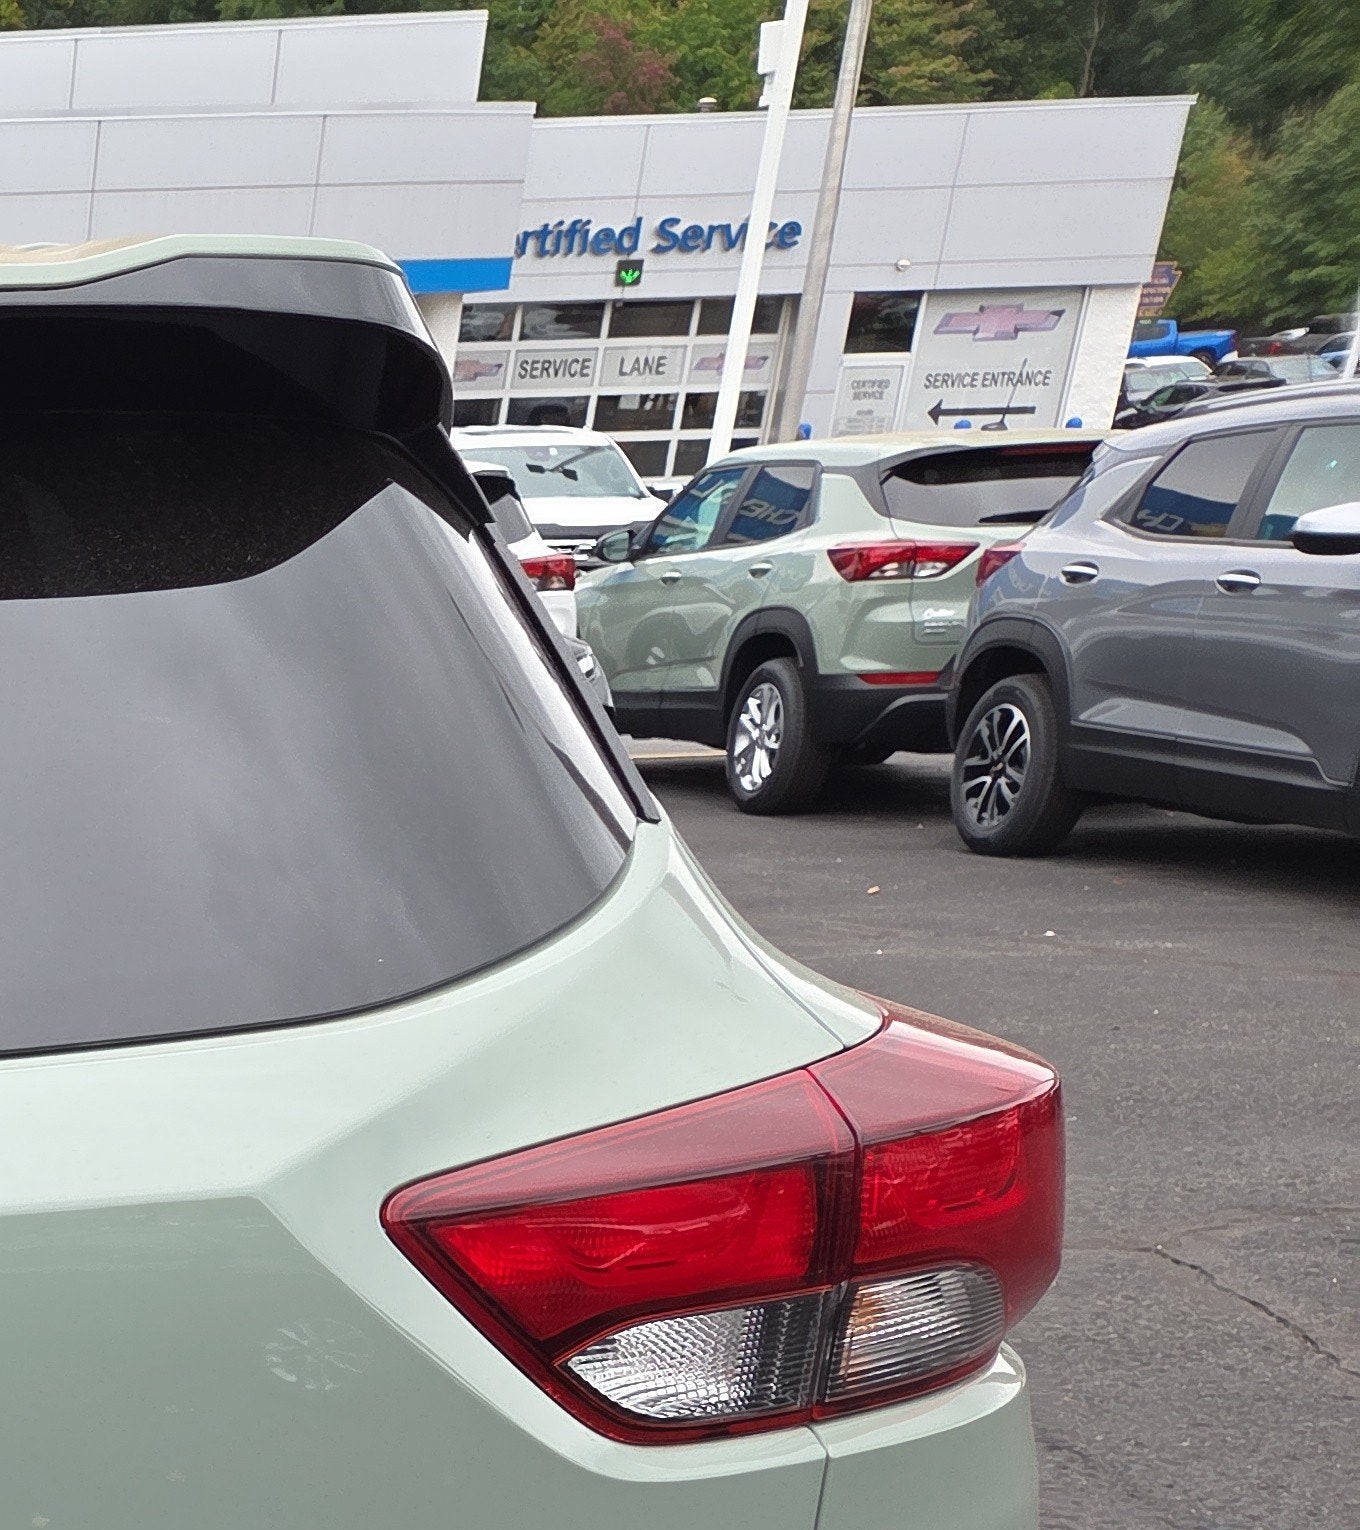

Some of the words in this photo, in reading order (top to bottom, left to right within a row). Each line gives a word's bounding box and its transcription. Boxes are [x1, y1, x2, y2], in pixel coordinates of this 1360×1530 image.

[515, 216, 643, 257] rtified
[651, 216, 803, 253] Servce
[518, 356, 593, 379] SERVICE
[618, 355, 668, 377] LANE
[923, 371, 979, 390] SERVICE
[981, 369, 1053, 388] ENTRANCE
